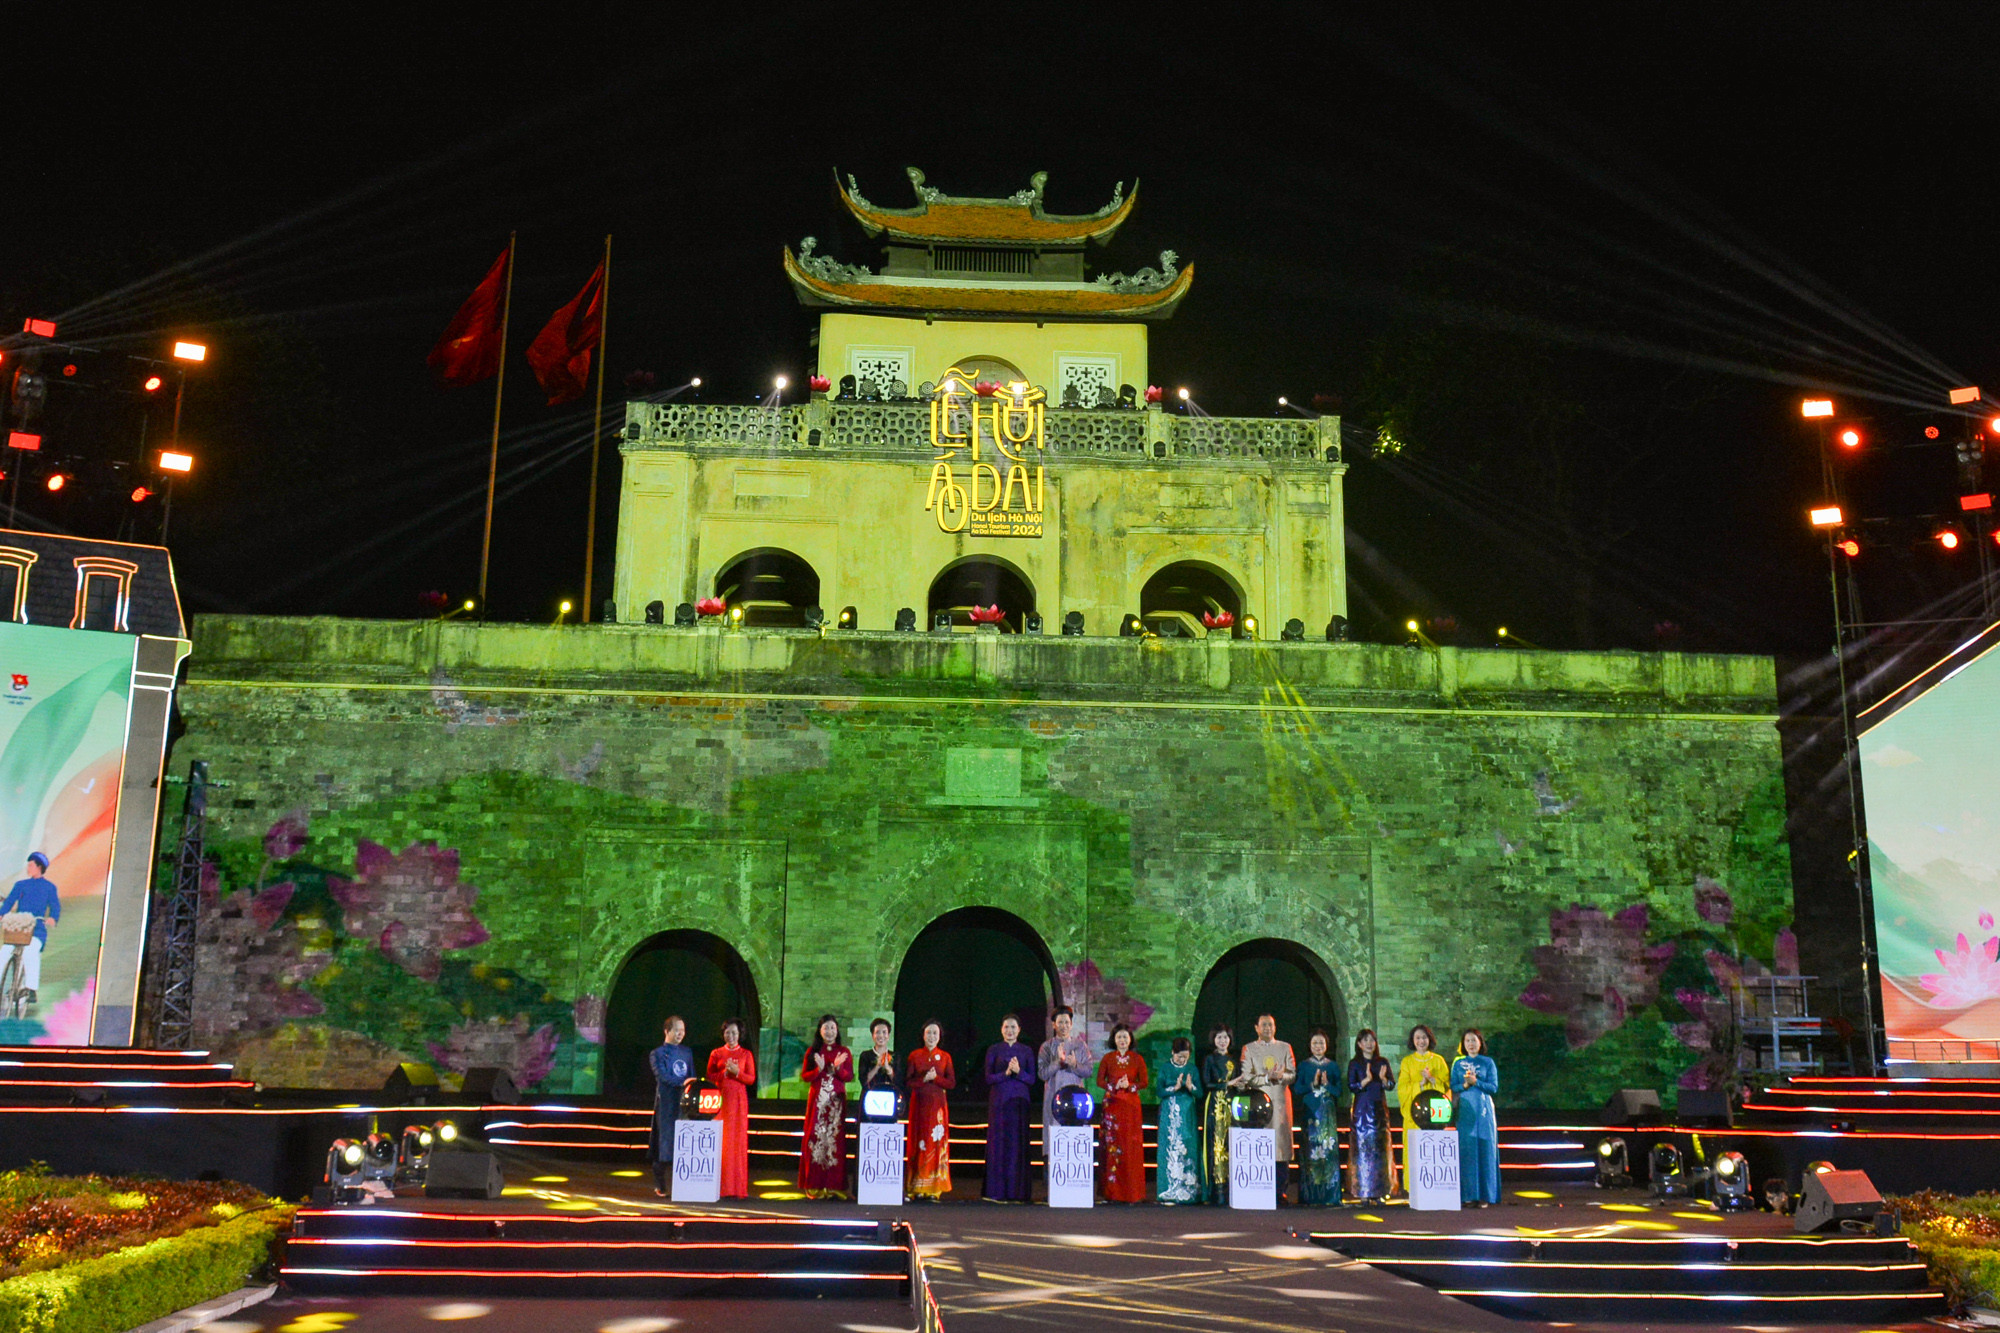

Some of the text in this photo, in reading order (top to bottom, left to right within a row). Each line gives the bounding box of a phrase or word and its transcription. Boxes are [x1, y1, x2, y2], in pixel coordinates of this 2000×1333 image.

[971, 512, 1043, 525] Du lịch Hà Nội
[1012, 525, 1043, 535] 2024
